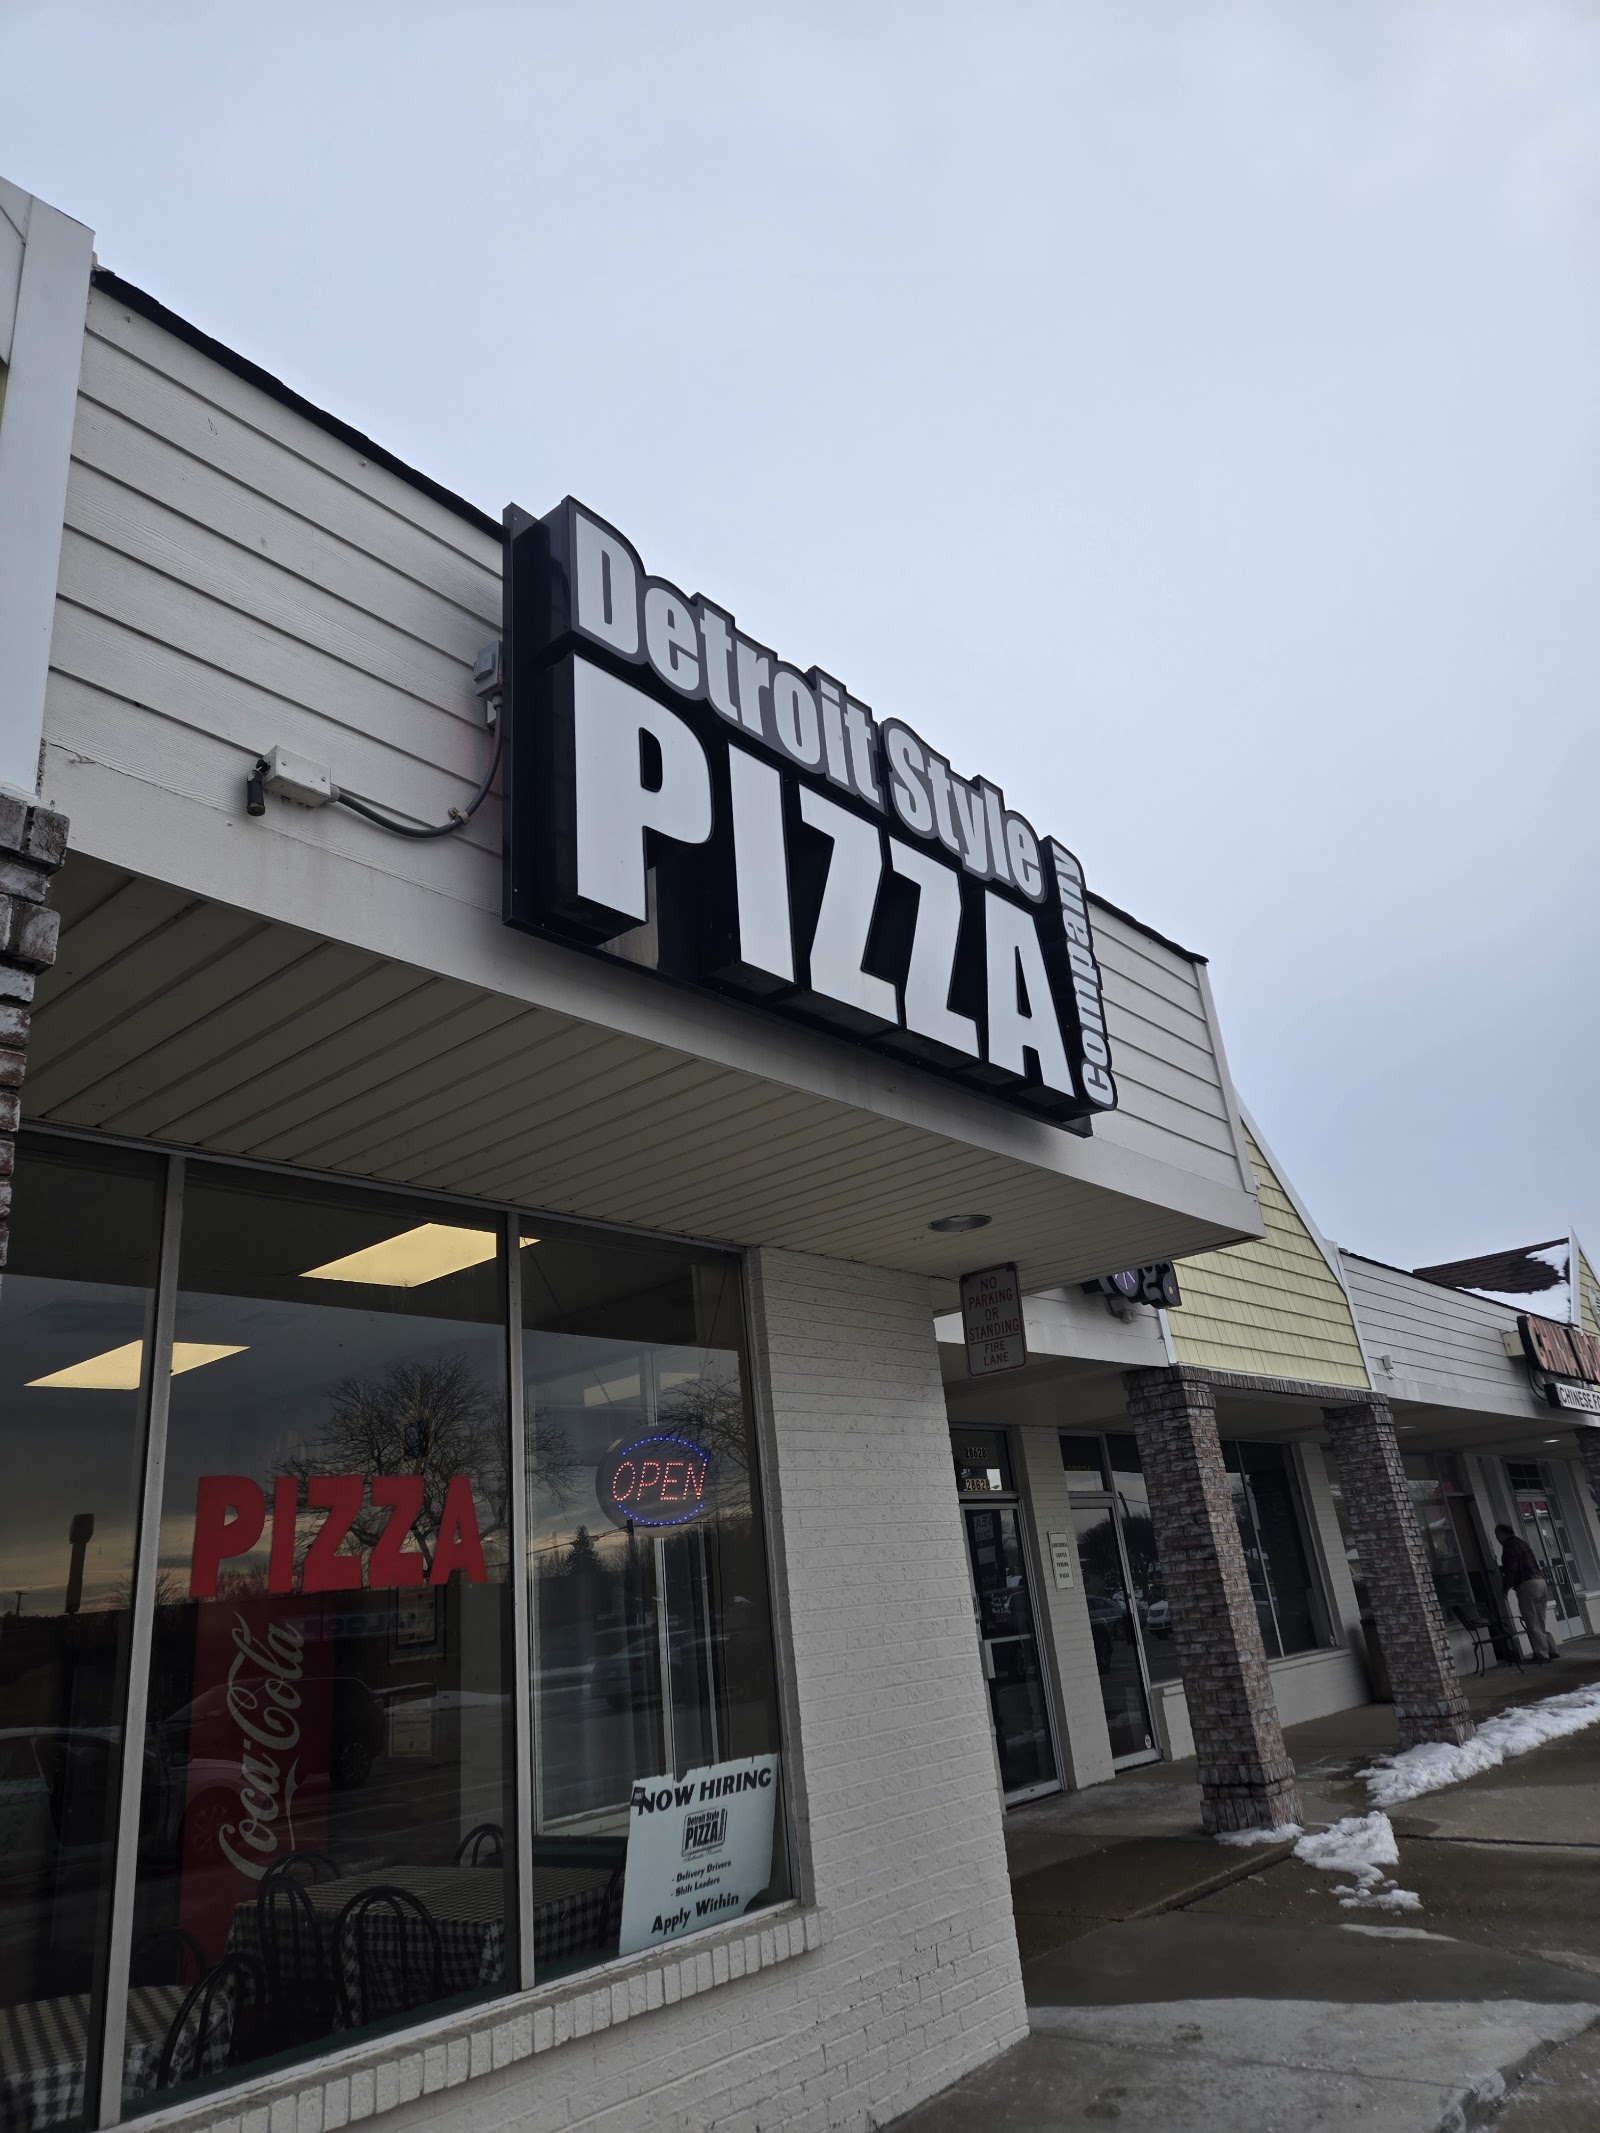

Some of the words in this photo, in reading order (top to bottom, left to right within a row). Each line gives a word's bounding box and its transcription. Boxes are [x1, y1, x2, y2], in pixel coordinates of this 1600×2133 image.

[573, 508, 884, 808] Detroit
[885, 724, 1045, 901] Style
[573, 652, 1077, 1100] PIZZA
[980, 1277, 997, 1291] NO
[968, 1288, 1012, 1309] PARKING
[985, 1307, 999, 1321] OR
[969, 1319, 1019, 1341] STANDING
[985, 1341, 1006, 1353] FIRE
[984, 1352, 1010, 1366] LANE
[1560, 1387, 1594, 1409] CHINESE
[965, 1447, 987, 1459] 28628
[612, 1461, 707, 1501] OPEN
[967, 1479, 991, 1491] 28628
[190, 1475, 488, 1596] PIZZA
[638, 1783, 696, 1816] NOW
[699, 1768, 771, 1802] HIRING
[685, 1820, 719, 1850] PIZZA
[677, 1869, 706, 1882] Delivery
[707, 1860, 732, 1873] Drivers
[676, 1883, 693, 1897] Shift
[695, 1877, 720, 1891] Leaders
[651, 1907, 691, 1935] Apply
[696, 1892, 739, 1917] Within
